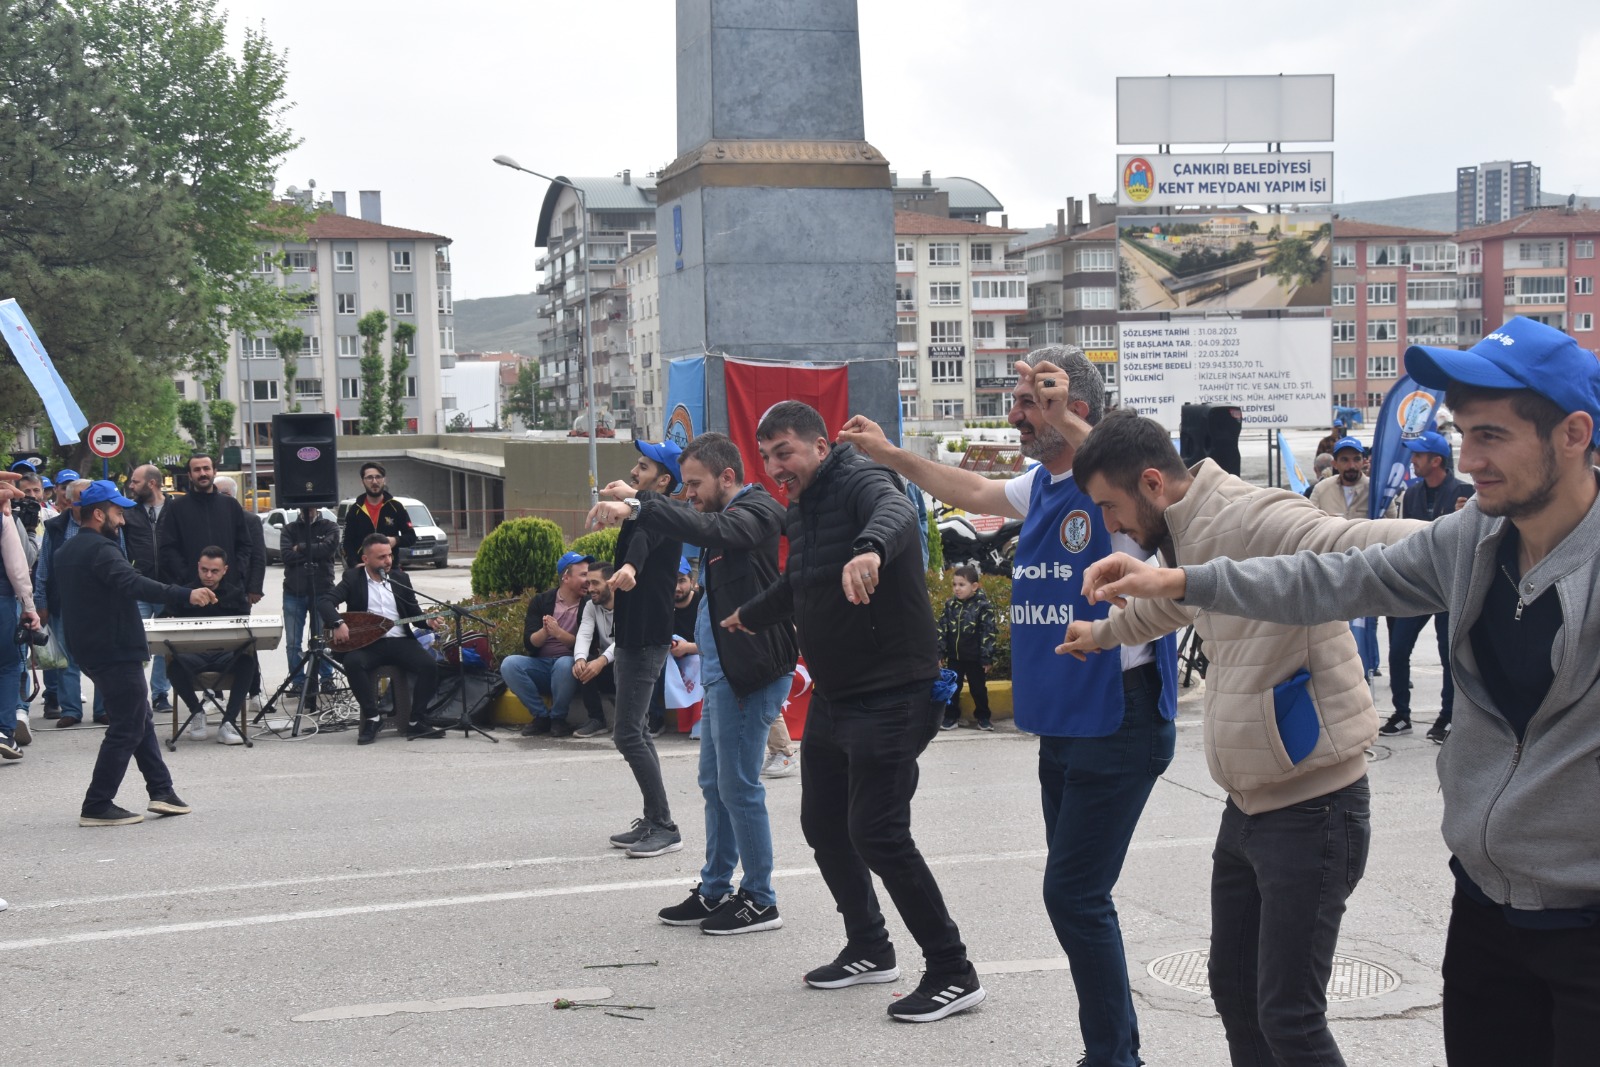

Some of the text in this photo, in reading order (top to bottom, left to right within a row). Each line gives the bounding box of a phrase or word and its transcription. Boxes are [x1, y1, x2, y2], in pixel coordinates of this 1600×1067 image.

[1173, 159, 1311, 177] ÇANKIRI BELEDİYESİ
[1158, 177, 1326, 194] KENT MEYDANI YAPIM İŞİ
[1122, 328, 1163, 337] SÖZLEŞME
[1164, 327, 1190, 336] TARİHİ
[1198, 327, 1238, 336] 31.08.2023
[1123, 340, 1135, 349] İŞE
[1136, 340, 1174, 349] BAŞLAMA
[1123, 351, 1139, 360] İŞİN
[1140, 350, 1161, 359] BİTİM
[1163, 350, 1188, 358] TARİHİ
[1198, 350, 1239, 358] 22.03.2024
[1123, 362, 1164, 371] SÖZLEŞME
[1165, 360, 1192, 370] BEDELİ
[1255, 360, 1264, 368] TL
[1124, 373, 1164, 382] YÜKLENİCİ
[1198, 372, 1227, 380] İKİZLER
[1258, 370, 1291, 379] NAKLİYE
[1199, 382, 1234, 391] TAAHHÜT
[1158, 394, 1175, 404] ŞEFİ
[1199, 394, 1229, 402] YÜKSEK
[1267, 393, 1294, 401] AHMET
[1241, 404, 1275, 412] LEDİYESİ
